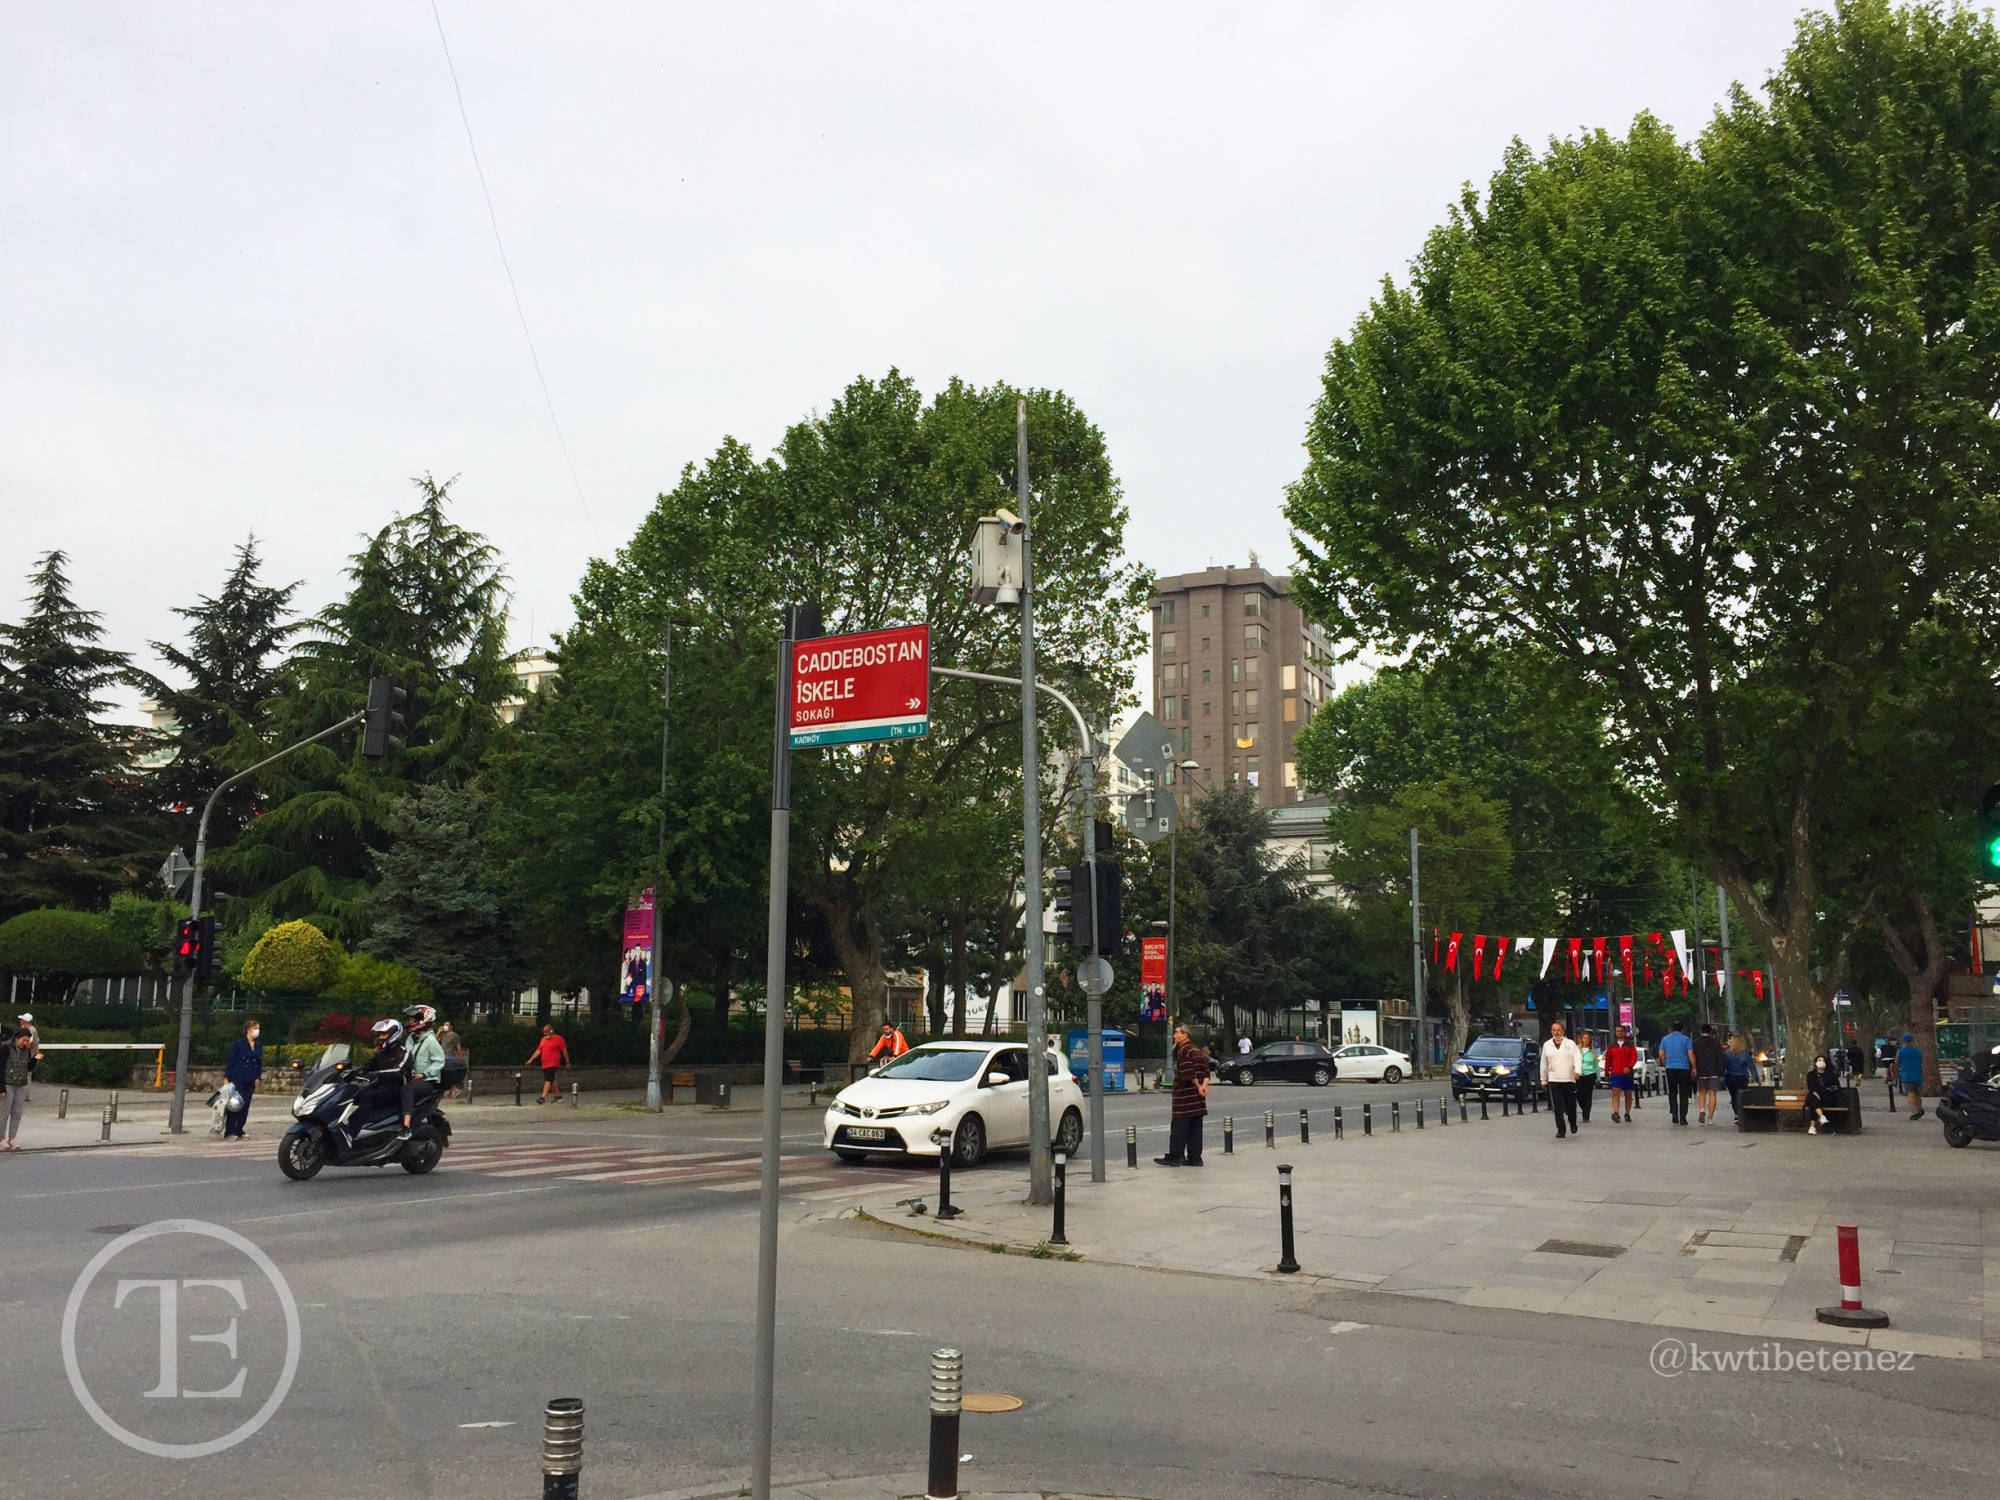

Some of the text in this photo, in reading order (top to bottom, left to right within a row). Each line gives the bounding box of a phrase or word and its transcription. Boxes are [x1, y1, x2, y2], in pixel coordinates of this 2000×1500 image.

[797, 639, 923, 674] CADDEBOSTAN
[797, 677, 855, 704] İSKELE
[796, 706, 835, 722] SOKAĞI
